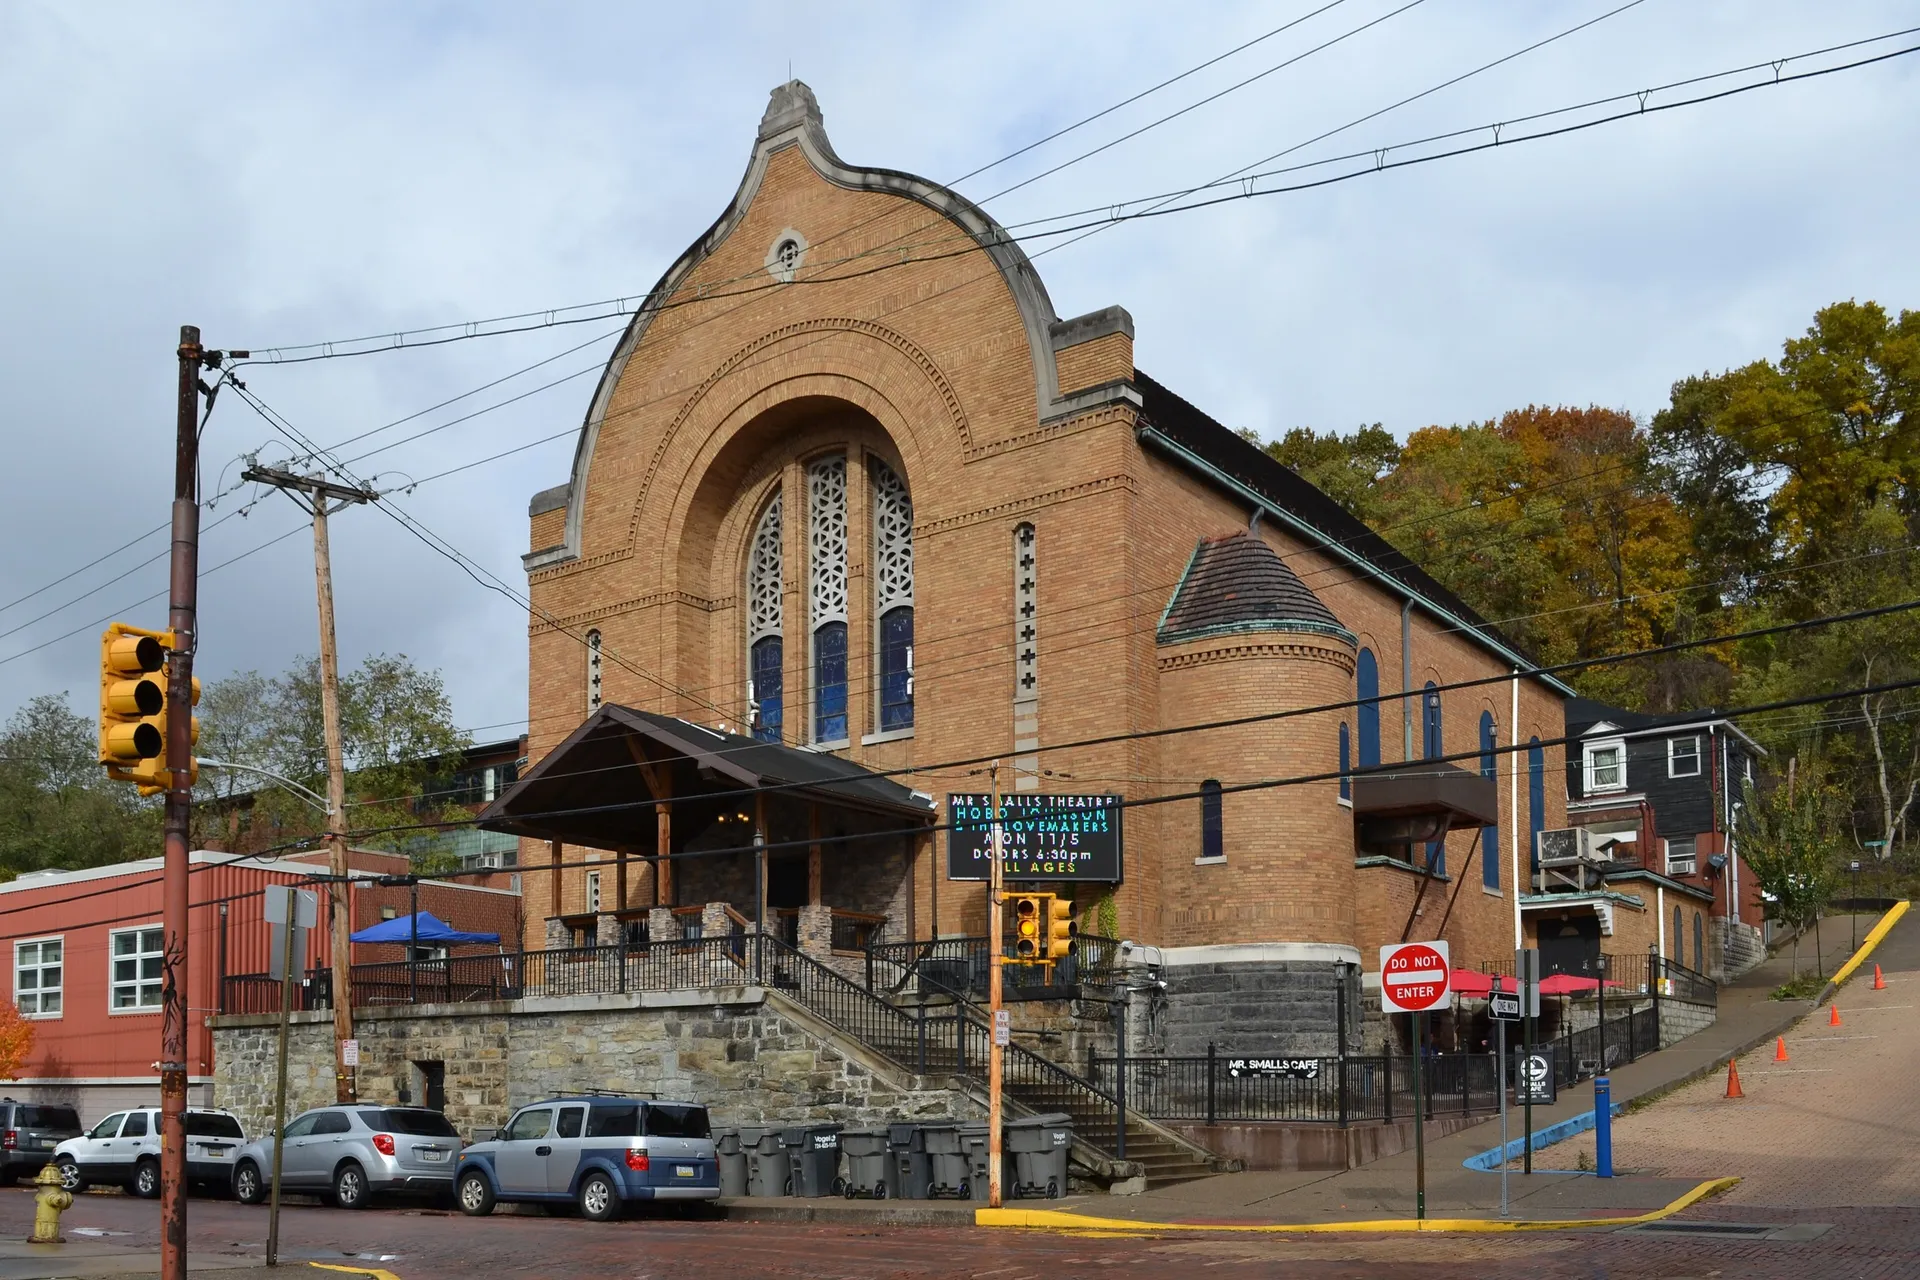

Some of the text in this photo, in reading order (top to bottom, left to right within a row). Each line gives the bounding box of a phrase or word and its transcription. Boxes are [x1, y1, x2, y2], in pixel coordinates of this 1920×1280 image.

[952, 796, 973, 806] MR
[1049, 796, 1113, 808] THEATRE
[956, 807, 1008, 819] HOBO
[1005, 821, 1109, 832] LOVEMAKERS
[1038, 832, 1079, 848] 11/5
[1004, 861, 1075, 873] LL AGES
[1391, 955, 1438, 969] DO NOT
[1396, 986, 1435, 999] ENTER
[1497, 1001, 1517, 1012] ONE WAY
[1229, 1058, 1318, 1070] MR. SMALLS CAFÉ
[814, 1134, 831, 1143] Vogel
